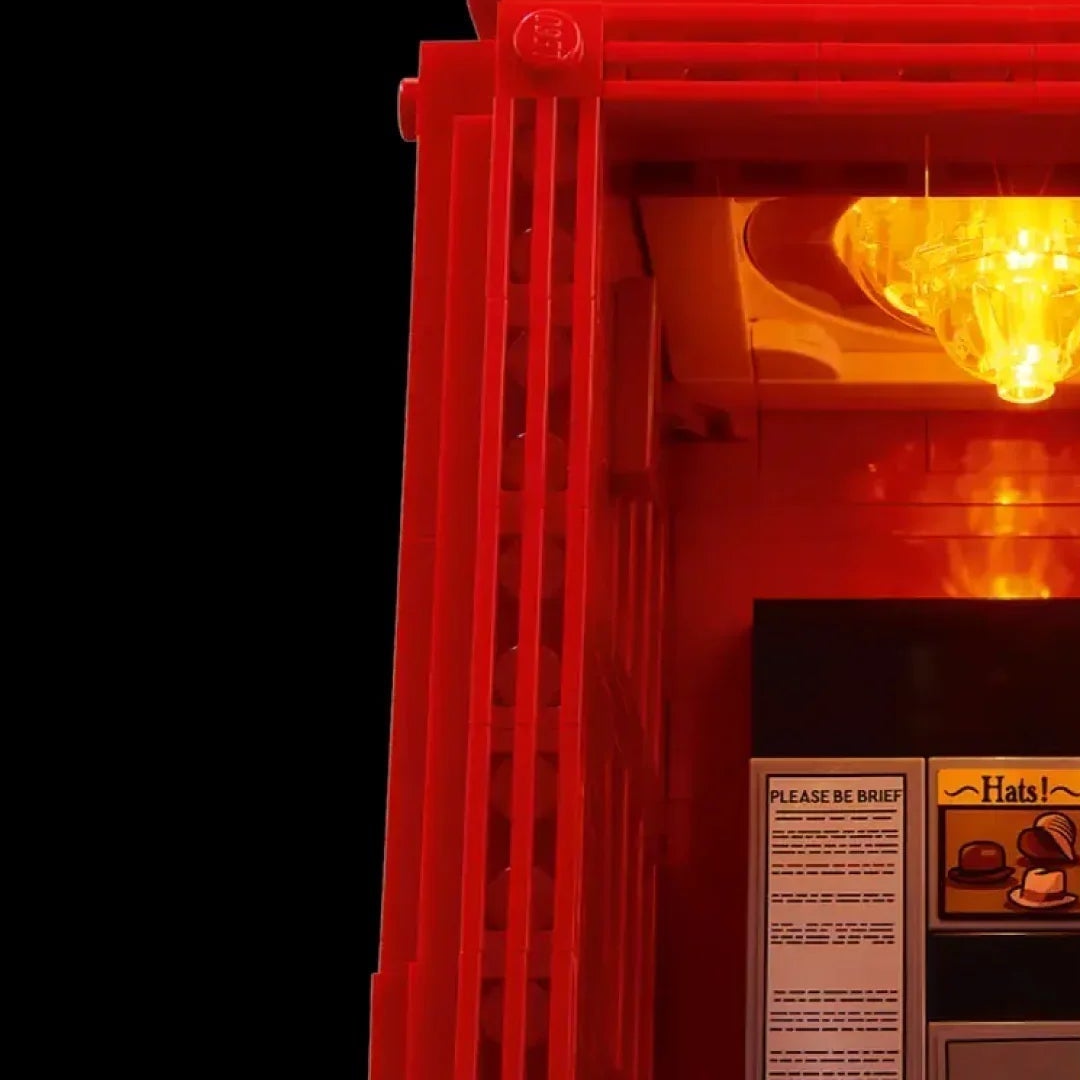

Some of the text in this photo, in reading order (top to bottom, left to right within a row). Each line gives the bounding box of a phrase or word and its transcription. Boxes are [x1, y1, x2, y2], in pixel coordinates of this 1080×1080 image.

[770, 789, 903, 804] PLEASE BE BRIEF
[981, 775, 1049, 804] Hats!
